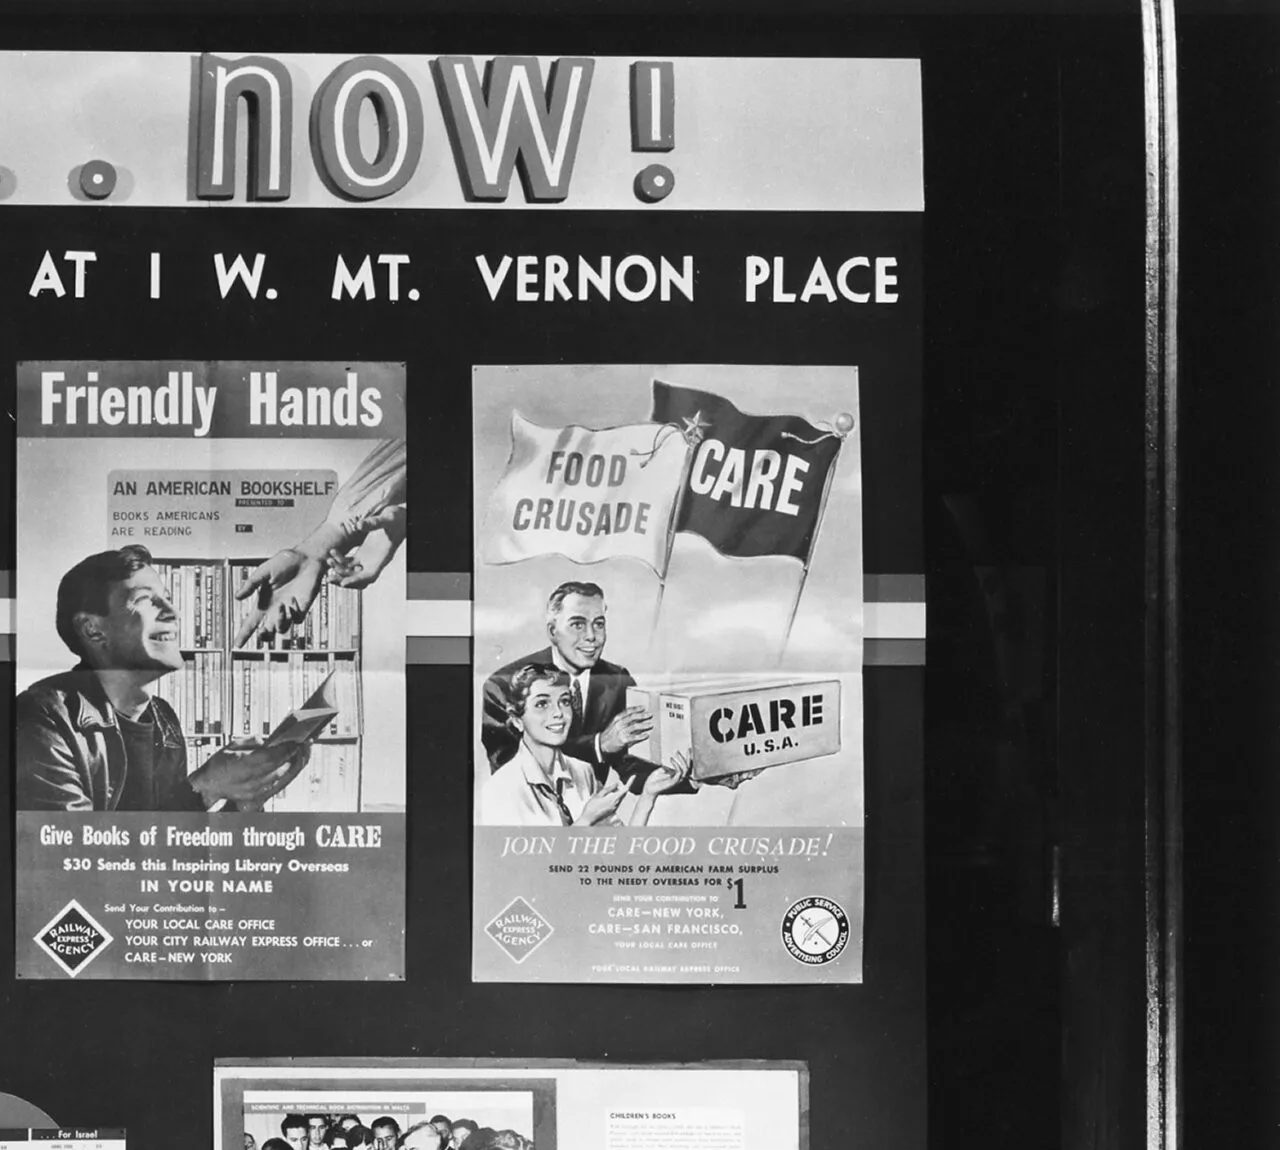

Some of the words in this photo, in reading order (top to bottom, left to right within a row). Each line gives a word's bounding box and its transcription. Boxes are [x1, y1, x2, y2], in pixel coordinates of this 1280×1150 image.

[29, 250, 97, 298] AT
[214, 253, 277, 299] W.
[331, 254, 420, 301] MT.
[475, 255, 694, 302] VERNON
[746, 255, 899, 303] PLACE
[41, 371, 217, 437] Friendly
[250, 372, 383, 427] Hands
[545, 450, 628, 487] FOOD
[690, 439, 810, 516] CARE
[113, 481, 137, 495] AN
[146, 481, 231, 495] AMERICAN
[241, 481, 335, 496] BOOKSHELF
[512, 498, 652, 537] CRUSADE
[709, 694, 823, 743] CARE
[744, 736, 798, 756] U.S.A.
[40, 825, 73, 845] Give
[83, 825, 130, 846] Books
[140, 826, 157, 846] of
[167, 826, 233, 846] Freedom
[242, 826, 305, 851] through
[316, 825, 381, 848] CARE
[501, 837, 556, 858] JOIN
[568, 836, 617, 855] THE
[628, 837, 696, 855] FOOD
[708, 833, 833, 856] CRUSADE!
[549, 865, 573, 873] SEND
[578, 865, 589, 873] 22
[594, 865, 633, 873] POUNDS
[638, 865, 650, 873] OF
[655, 865, 703, 873] AMERICAN
[739, 866, 779, 874] SURPLUS
[49, 921, 99, 940] RAILWAY
[125, 919, 158, 929] YOUR
[163, 919, 200, 930] LOCAL
[205, 919, 233, 930] CARE
[238, 920, 275, 930] OFFICE
[48, 940, 96, 956] AGENCY
[57, 935, 90, 944] EXPRESS
[75, 1130, 98, 1138] Israel
